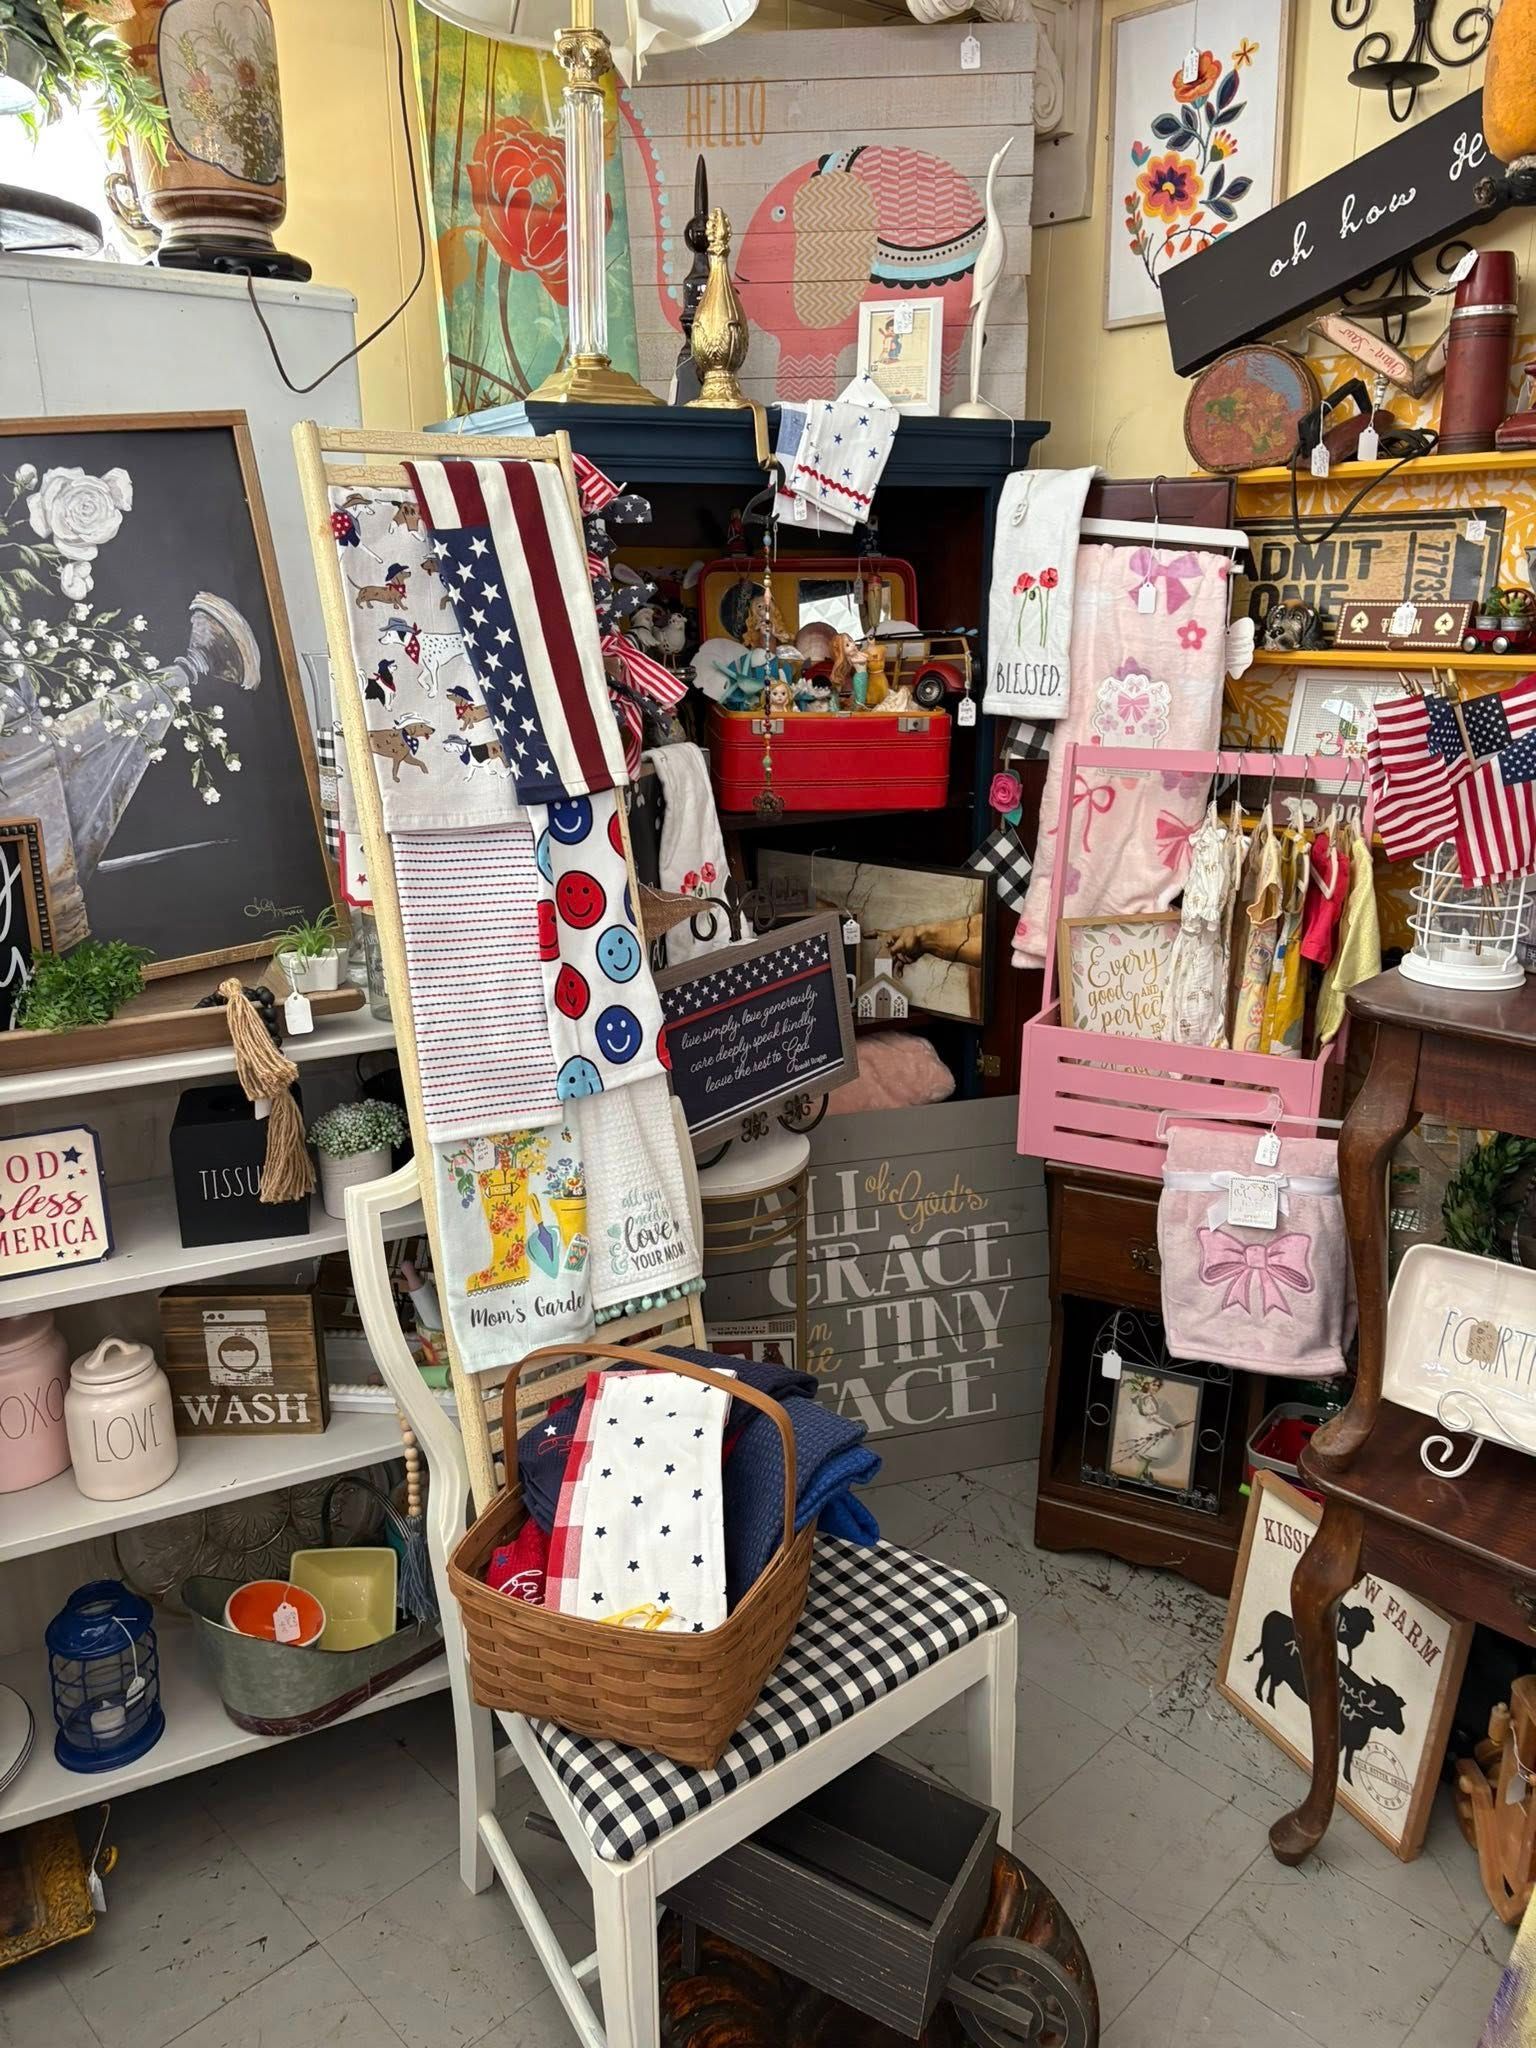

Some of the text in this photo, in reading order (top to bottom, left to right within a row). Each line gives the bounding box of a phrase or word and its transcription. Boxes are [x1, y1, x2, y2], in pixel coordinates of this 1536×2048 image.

[687, 76, 765, 148] HELLO
[1269, 132, 1487, 277] oh how ge
[1237, 539, 1382, 582] ADMIT
[996, 662, 1061, 696] BLESSED.
[1087, 945, 1168, 987] Every
[1088, 973, 1159, 1020] good AND
[681, 1032, 700, 1049] live
[703, 1014, 741, 1042] simply,
[742, 1009, 762, 1026] love
[690, 1055, 714, 1073] care
[752, 1021, 781, 1053] speak
[705, 1076, 734, 1093] leave
[734, 1061, 751, 1080] the
[752, 1052, 773, 1072] rest
[772, 1051, 782, 1062] to
[5, 1151, 59, 1184] OD
[199, 1165, 262, 1201] TISSU
[0, 1184, 88, 1225] less
[865, 1161, 891, 1202] of
[889, 1170, 988, 1233] God's
[0, 1216, 98, 1256] MERICA
[624, 1216, 673, 1253] love
[631, 1250, 664, 1271] YOUR
[664, 1241, 686, 1262] MOM
[768, 1221, 1012, 1308] GRACE
[470, 1290, 585, 1328] Mom's Garde
[847, 1286, 1014, 1369] TINY
[1438, 1311, 1536, 1385] FOURT
[0, 1377, 64, 1440] OXO
[180, 1392, 311, 1427] WASH
[93, 1400, 162, 1463] LOVE
[1263, 1517, 1310, 1553] KISSI
[1382, 1595, 1442, 1667] FARM
